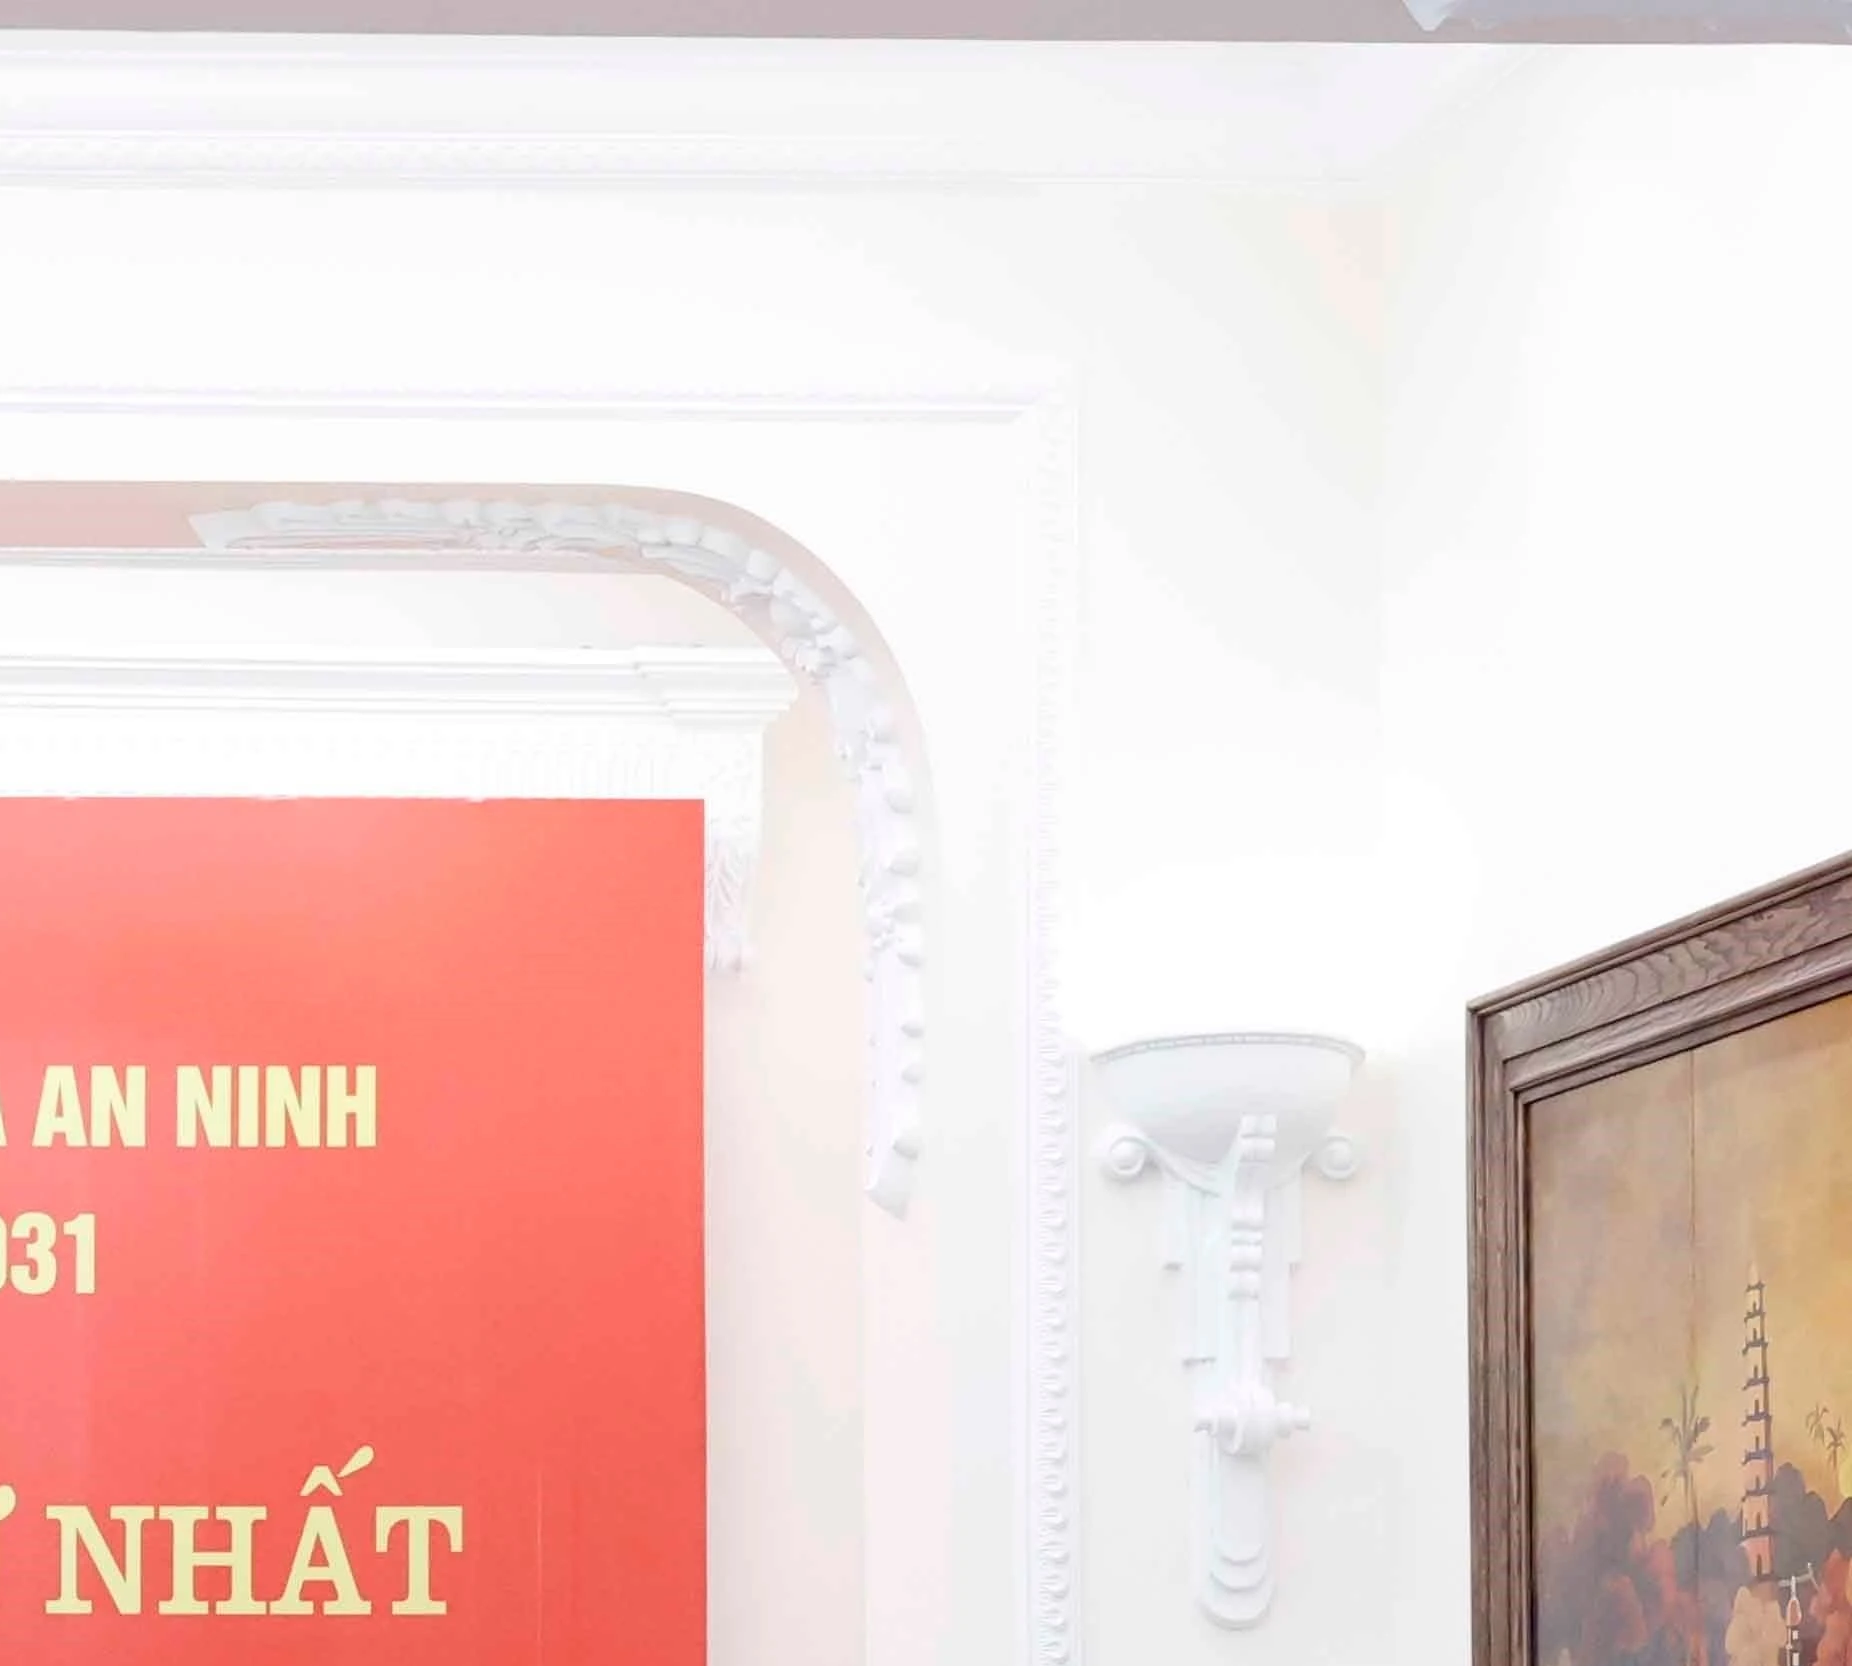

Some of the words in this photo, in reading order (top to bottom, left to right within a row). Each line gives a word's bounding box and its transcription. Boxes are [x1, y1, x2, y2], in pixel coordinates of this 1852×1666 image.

[31, 1065, 146, 1147] AN
[176, 1065, 378, 1148] NINH
[45, 1446, 464, 1616] NHẤT
